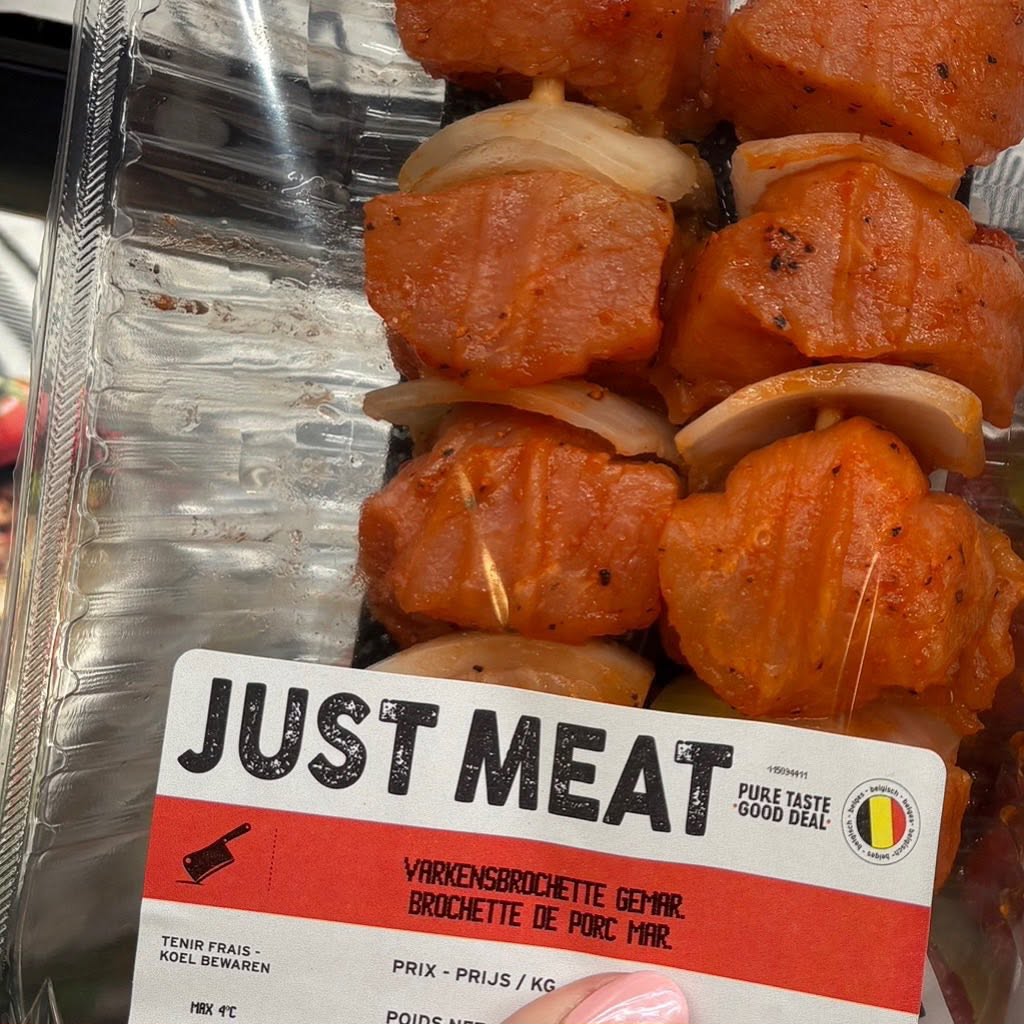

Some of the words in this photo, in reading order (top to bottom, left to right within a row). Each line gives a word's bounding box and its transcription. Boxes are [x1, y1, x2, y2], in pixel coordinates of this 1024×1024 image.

[177, 677, 439, 795] JUST
[454, 708, 734, 836] MEAT
[738, 783, 782, 804] PURE
[786, 790, 831, 813] TASTE
[738, 801, 783, 822] GOOD
[788, 809, 827, 830] DEAL
[404, 857, 607, 908] VARKENSBROCHETTE
[615, 887, 686, 920] GEMAR.
[408, 890, 524, 927] BROCHETTE
[533, 904, 559, 931] DE
[568, 910, 618, 942] PORC
[627, 920, 673, 950] MAR.
[161, 935, 204, 951] TENIR
[208, 941, 251, 957] FRAIS
[160, 950, 197, 965] KOEL
[201, 955, 271, 974] BEWAREN
[392, 959, 437, 978] PRIX
[456, 967, 511, 988] PRIJS
[515, 973, 527, 991] /
[530, 976, 556, 993] KG
[190, 1001, 214, 1016] MAX
[218, 1004, 237, 1018] 4°C
